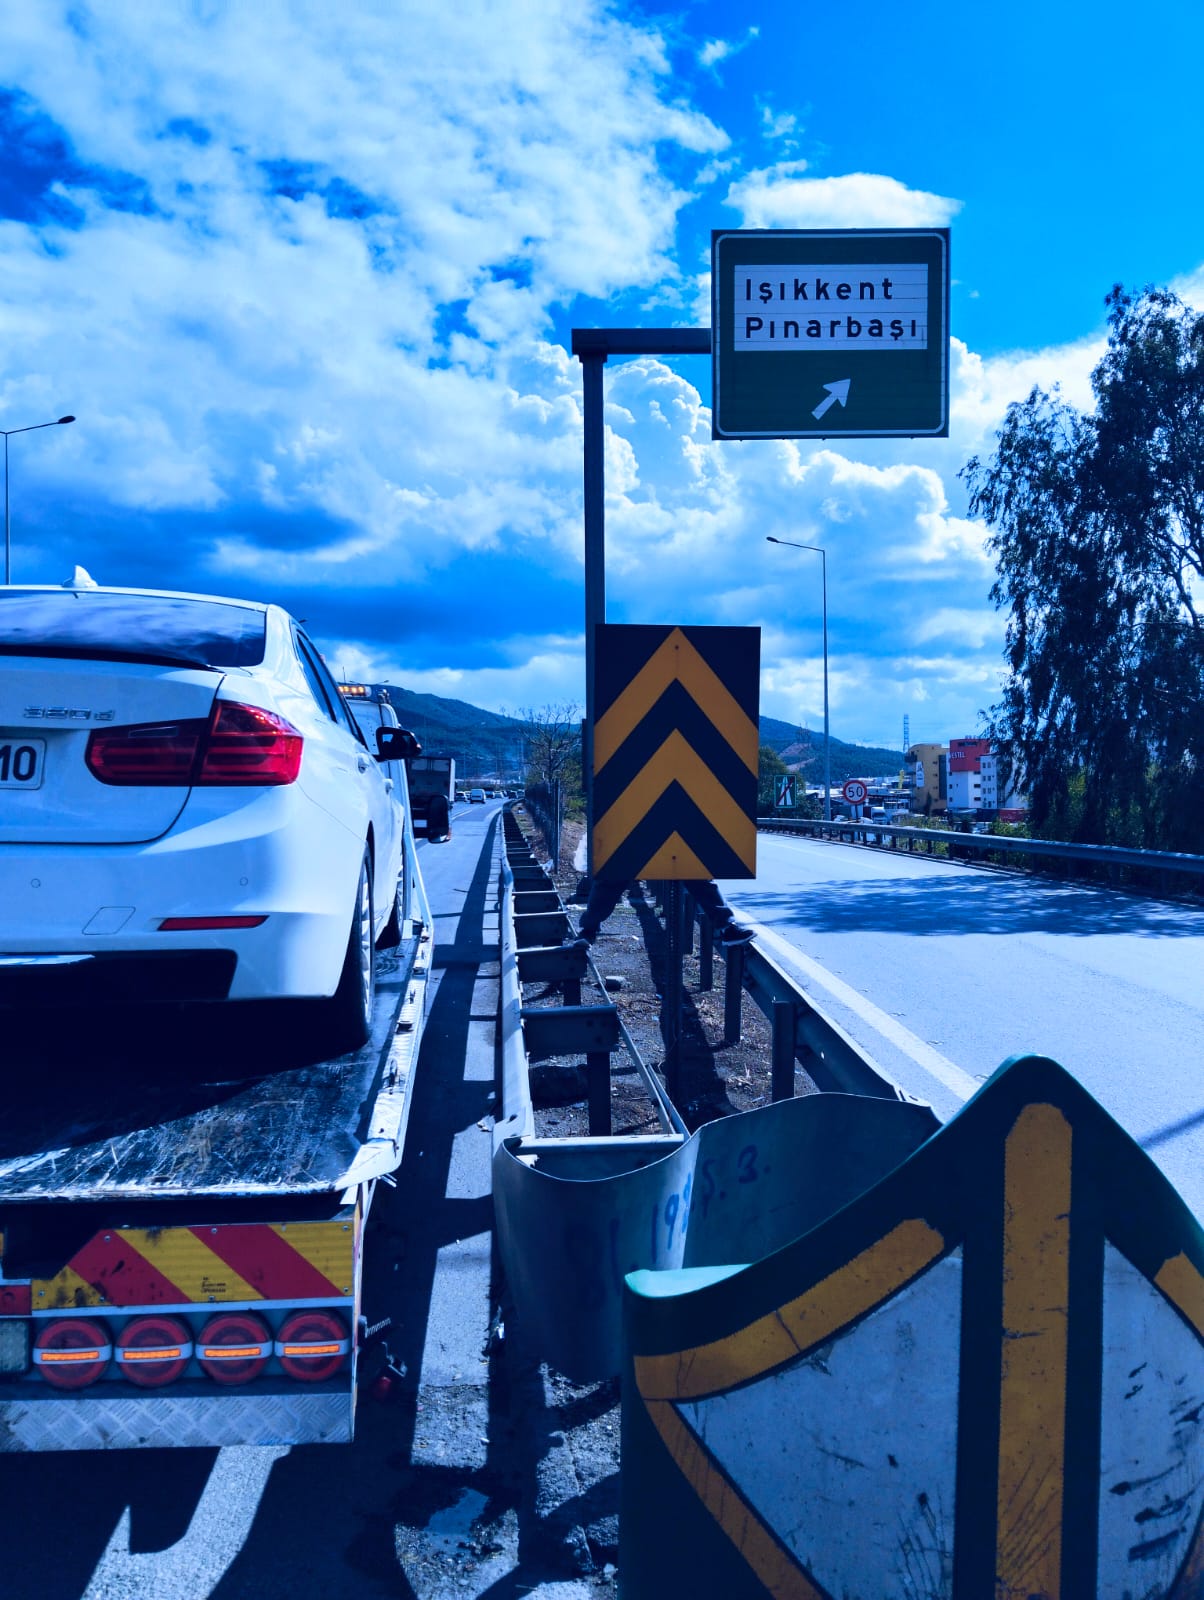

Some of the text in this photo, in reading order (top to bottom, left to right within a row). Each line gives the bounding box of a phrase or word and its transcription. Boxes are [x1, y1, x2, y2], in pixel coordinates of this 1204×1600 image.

[746, 278, 893, 304] Işıkkent
[746, 315, 917, 341] Pınarbaşı
[847, 786, 863, 798] 50
